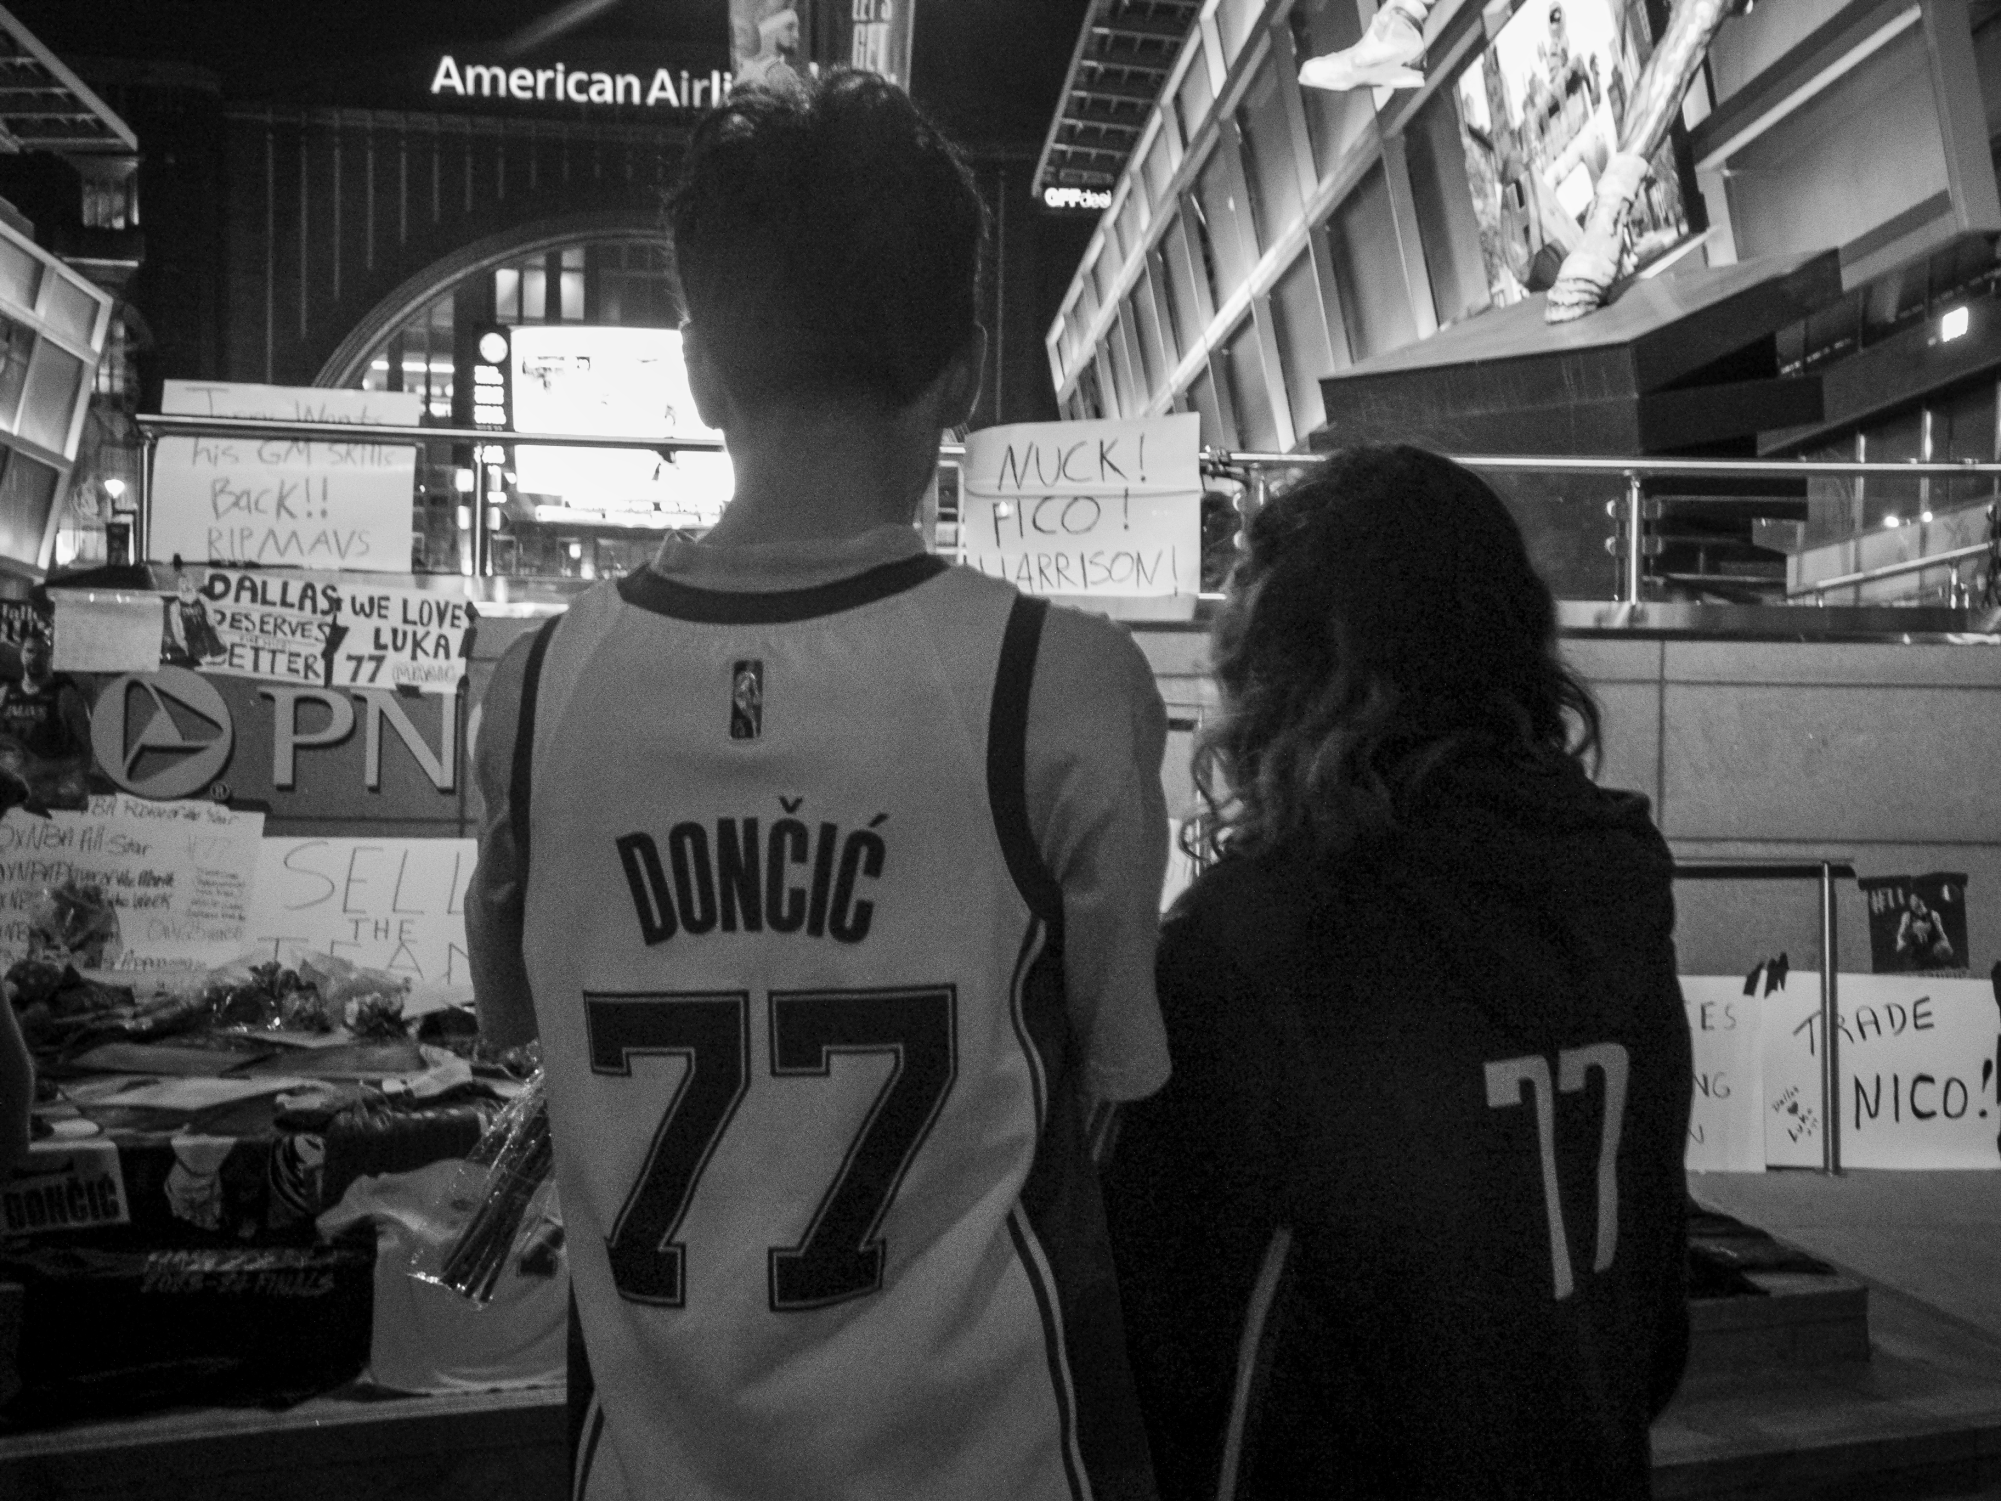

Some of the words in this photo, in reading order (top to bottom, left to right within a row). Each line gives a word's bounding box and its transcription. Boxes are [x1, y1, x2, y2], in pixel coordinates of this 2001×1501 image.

[431, 55, 641, 105] American
[257, 439, 311, 465] GM
[997, 432, 1146, 491] NUCK!
[206, 573, 341, 616] DALLAS
[351, 595, 391, 619] WE
[402, 598, 466, 629] LOVE
[374, 626, 450, 661] LUKA
[346, 654, 387, 683] 77
[614, 796, 891, 946] DONČIĆ
[348, 916, 418, 944] THE
[1853, 1058, 1994, 1131] NICO!
[583, 982, 958, 1313] 77
[1483, 1041, 1630, 1301] 77
